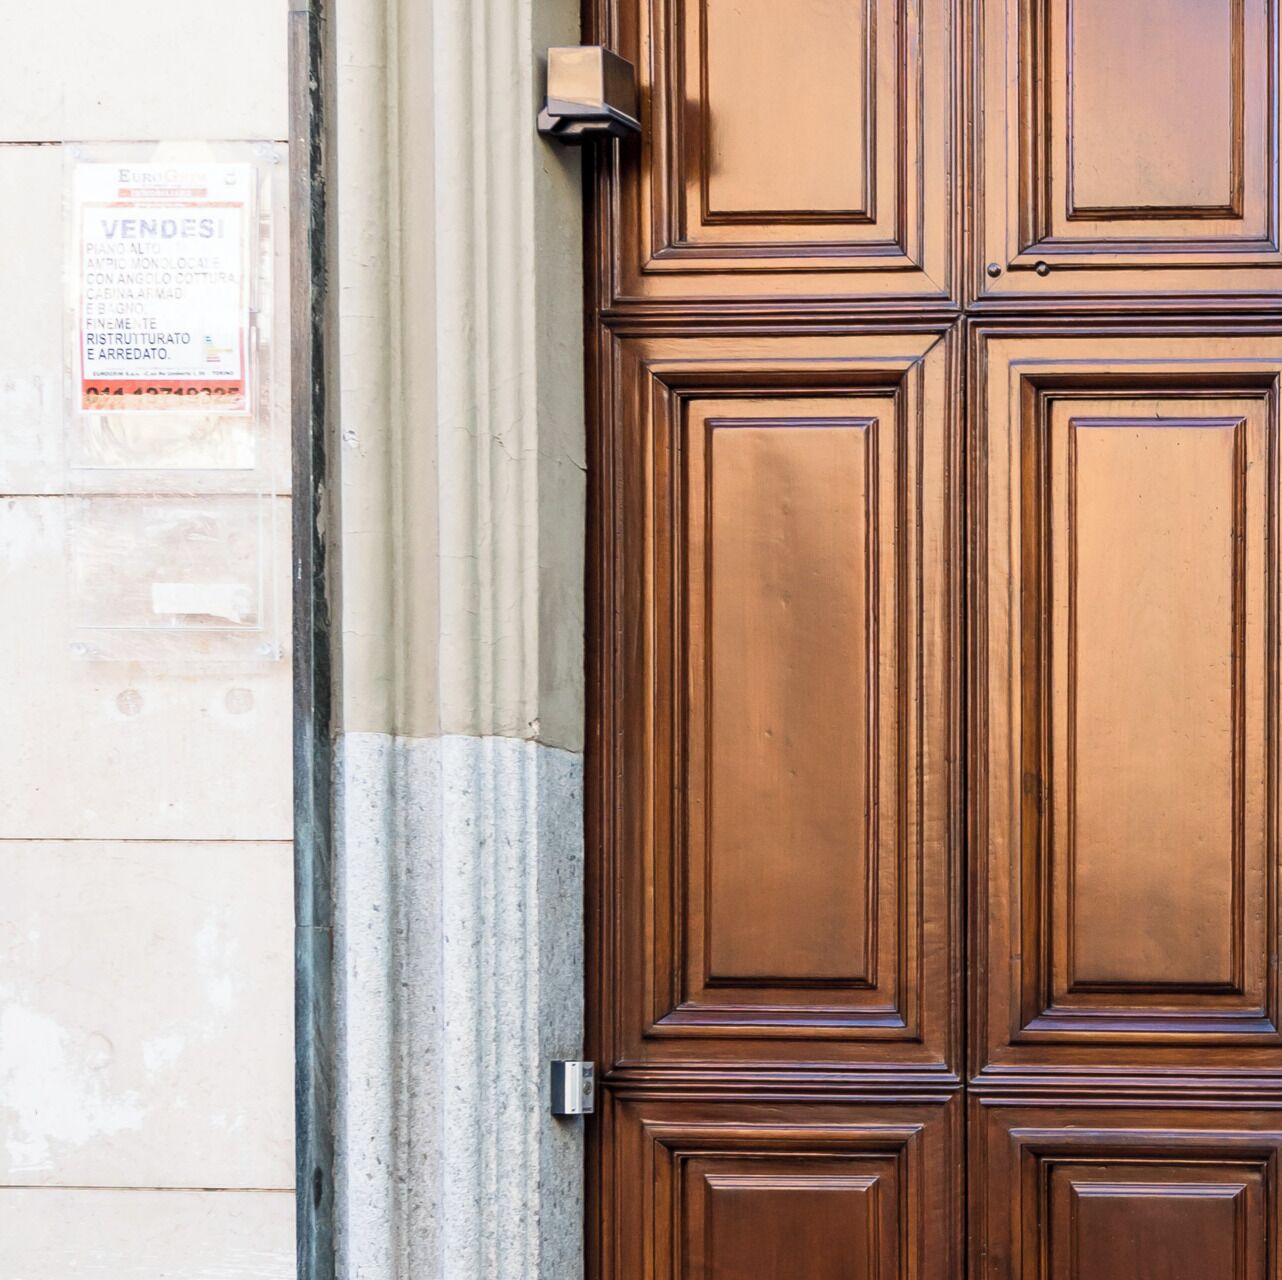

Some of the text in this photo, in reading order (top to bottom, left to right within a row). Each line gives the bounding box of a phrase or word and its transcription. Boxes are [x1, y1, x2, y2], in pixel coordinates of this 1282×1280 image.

[100, 219, 225, 239] VENDESI
[86, 242, 161, 255] PIANO ALTO
[86, 272, 114, 285] CON
[117, 272, 172, 285] ANGOLO
[87, 333, 191, 345] RISTRUTTURATO
[87, 348, 171, 360] E ARREDATO.
